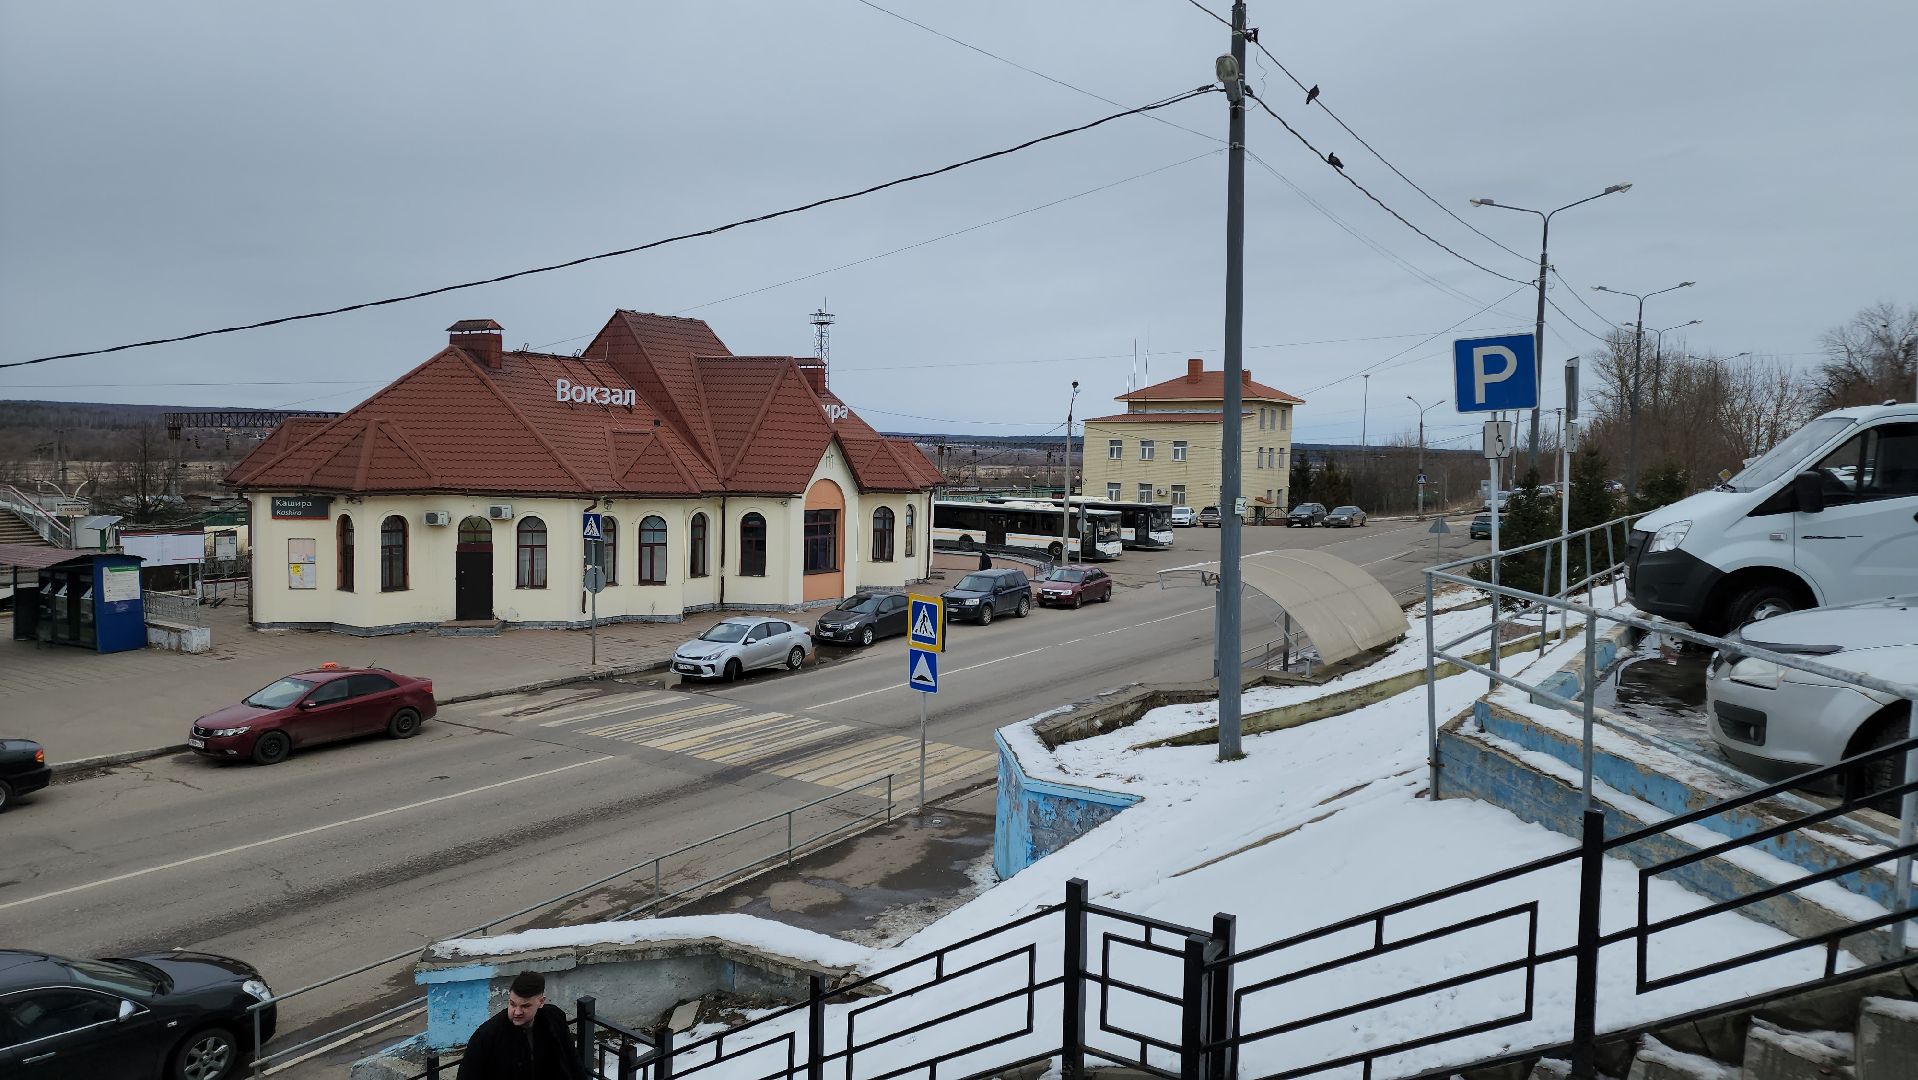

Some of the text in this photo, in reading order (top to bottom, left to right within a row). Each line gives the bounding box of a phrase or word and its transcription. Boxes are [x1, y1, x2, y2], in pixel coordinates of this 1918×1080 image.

[1473, 345, 1518, 404] P
[556, 378, 636, 406] Вокзал
[275, 499, 312, 508] Кашира
